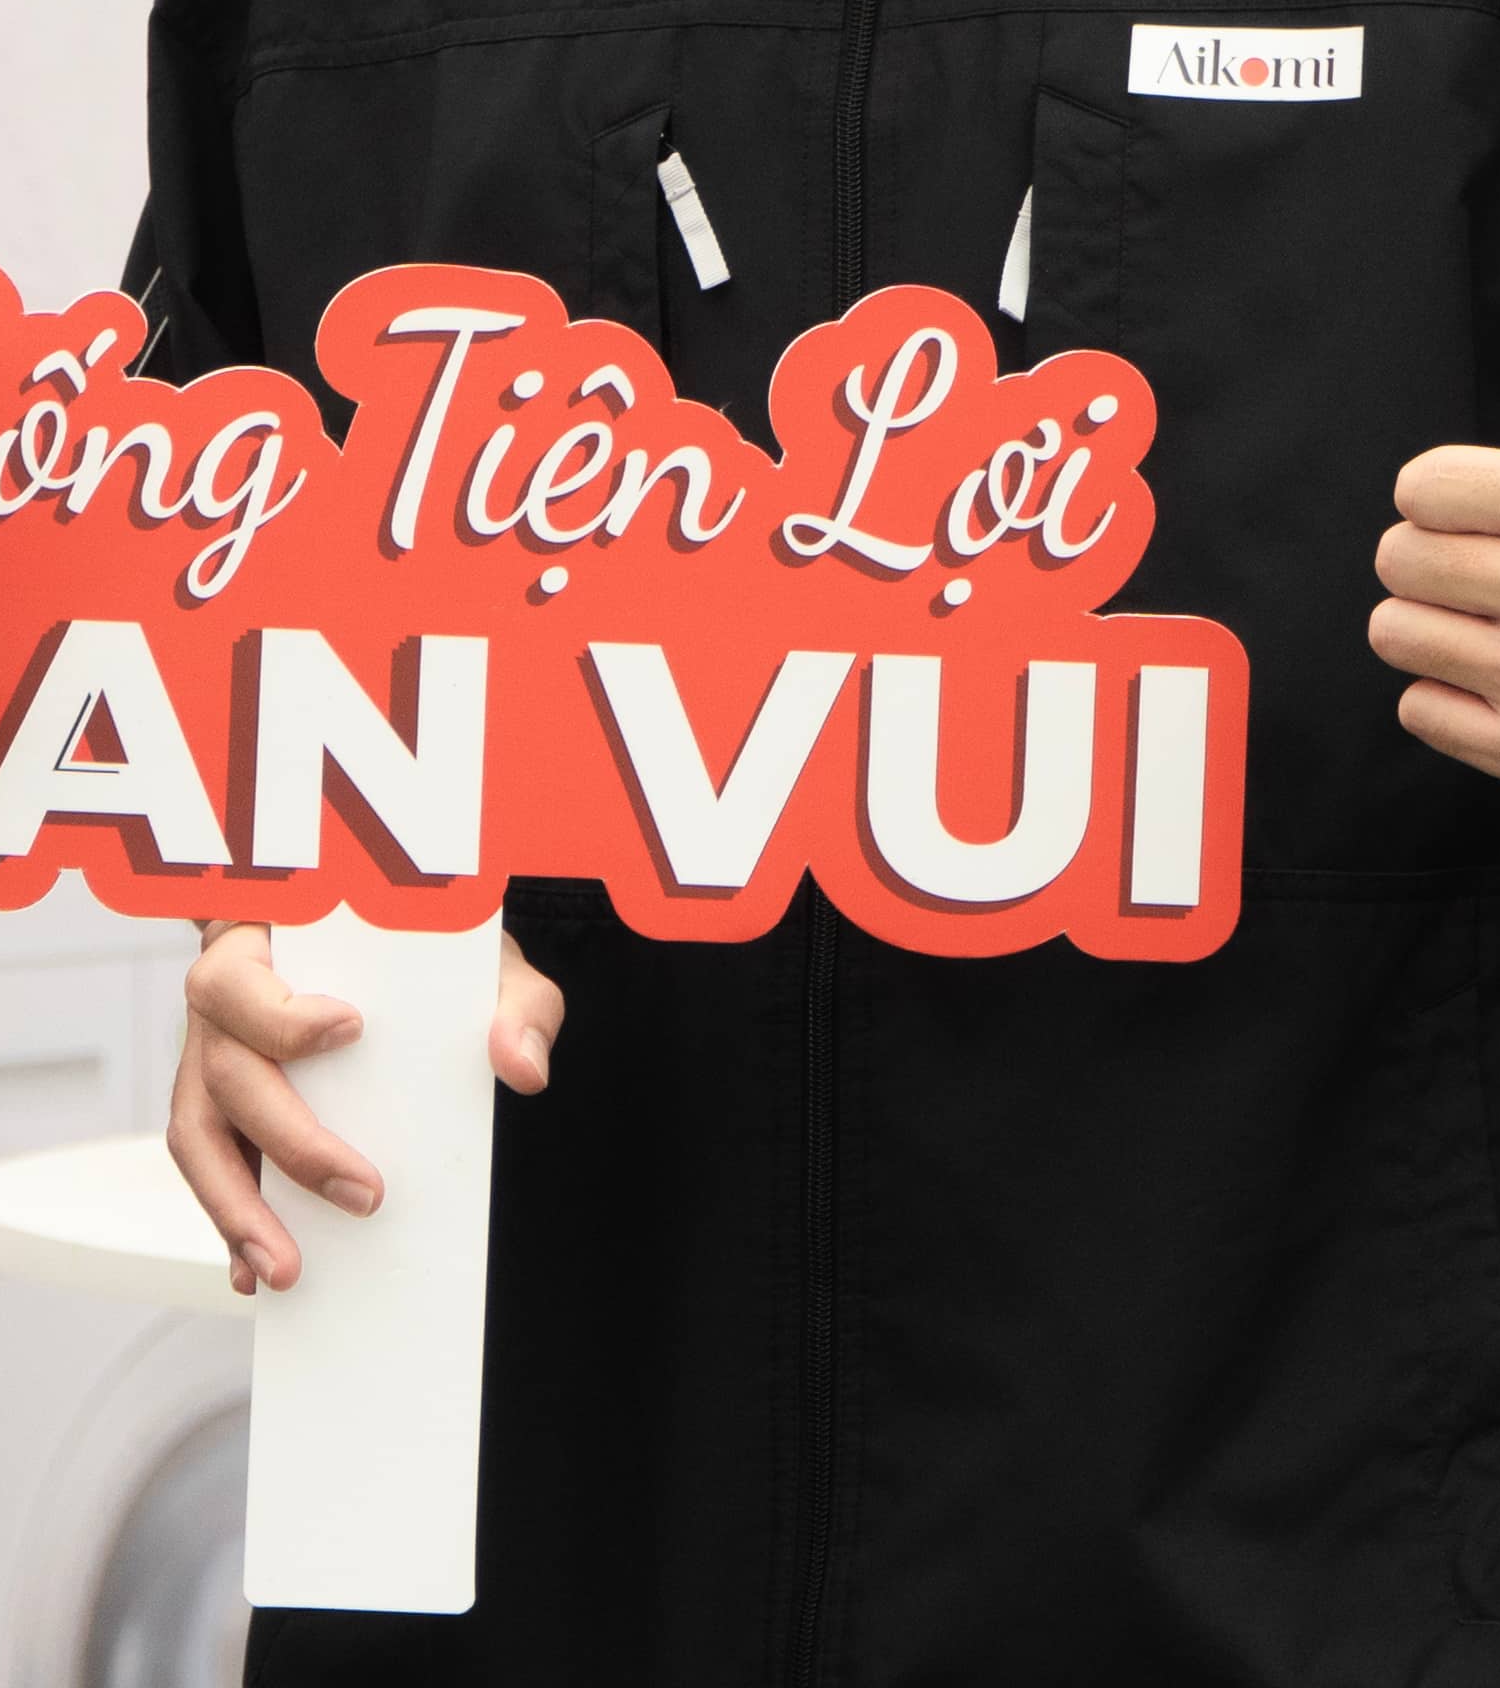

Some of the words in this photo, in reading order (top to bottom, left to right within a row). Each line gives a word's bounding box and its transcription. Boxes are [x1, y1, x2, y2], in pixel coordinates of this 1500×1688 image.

[1156, 39, 1336, 89] Aikomi
[388, 308, 746, 596] Tiện
[782, 327, 1117, 605] Lợi
[590, 640, 1210, 906] VUI
